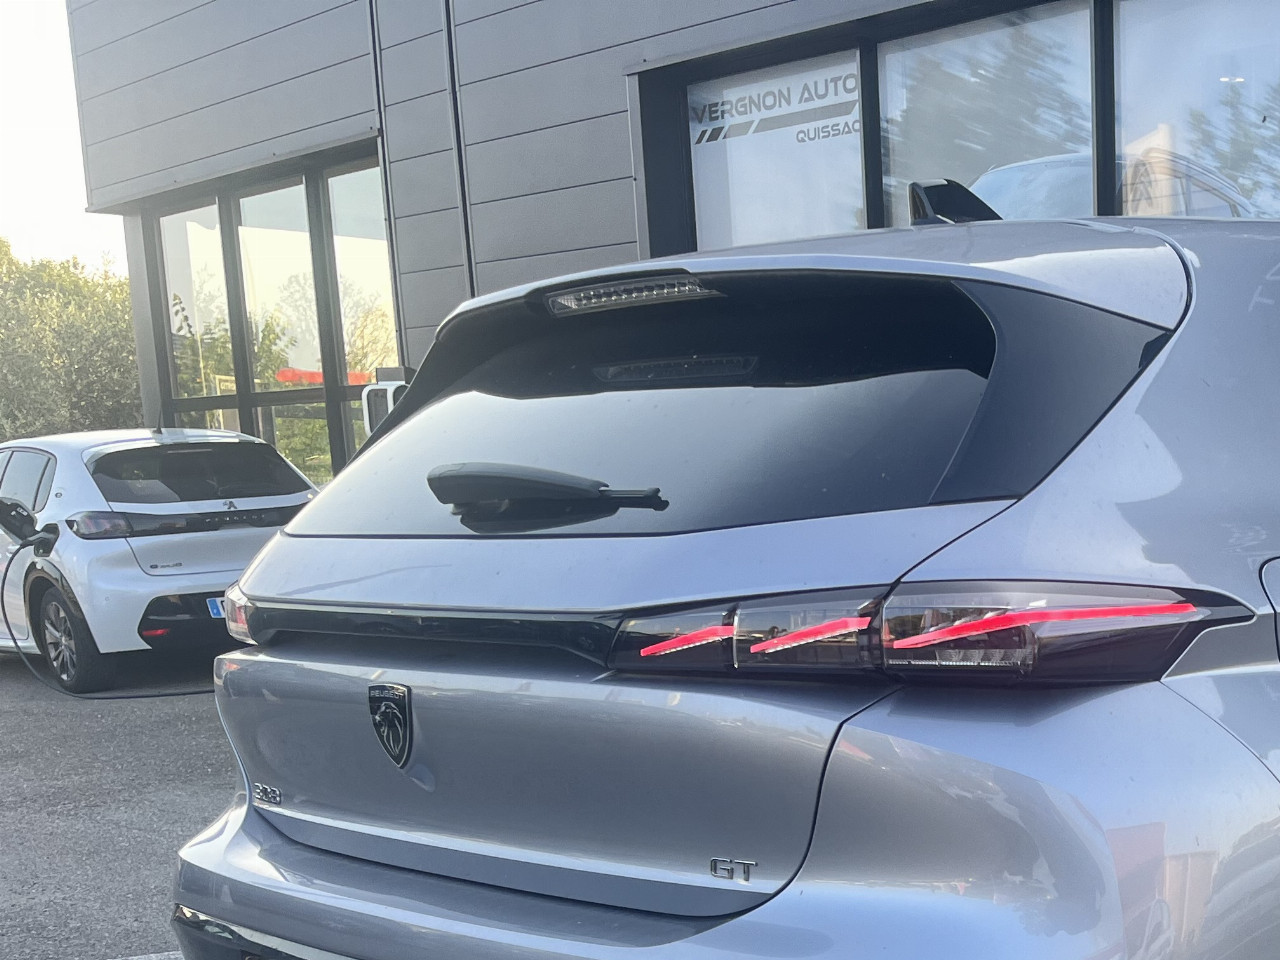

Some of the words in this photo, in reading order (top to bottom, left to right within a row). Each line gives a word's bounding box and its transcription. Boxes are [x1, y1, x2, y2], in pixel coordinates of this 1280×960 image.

[692, 87, 791, 123] VERGNON
[797, 72, 859, 105] AUTO
[796, 119, 862, 143] QUISSAC
[711, 857, 758, 881] GT
